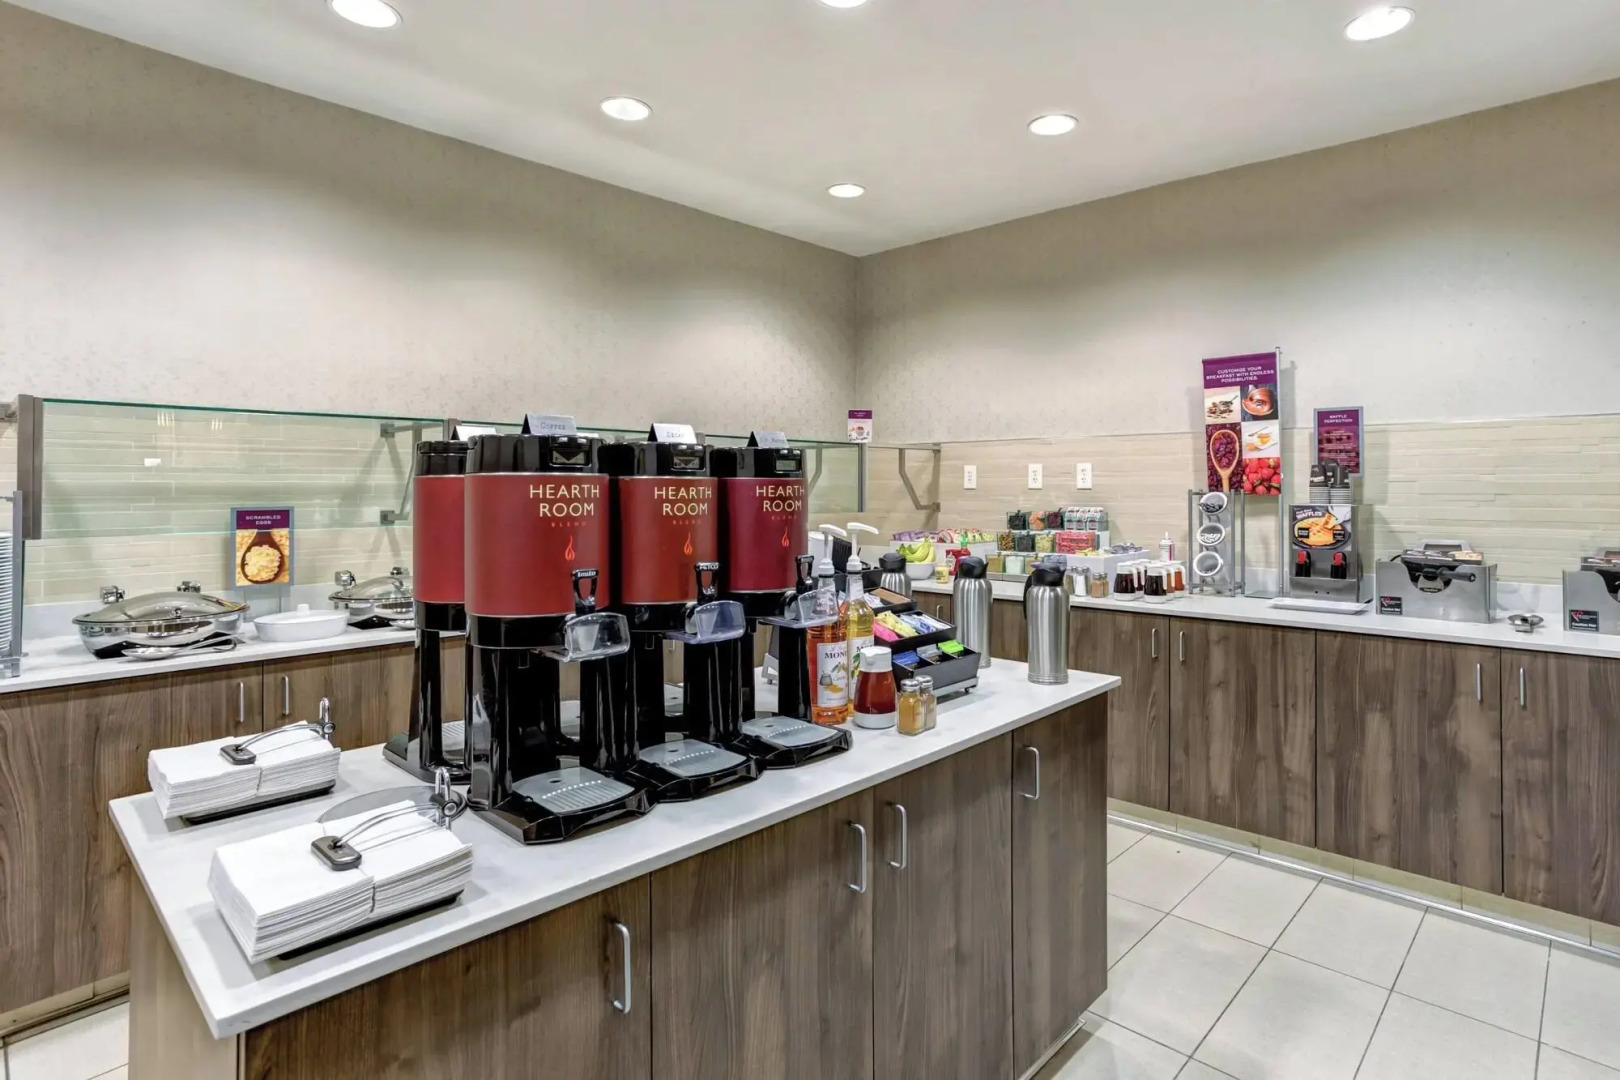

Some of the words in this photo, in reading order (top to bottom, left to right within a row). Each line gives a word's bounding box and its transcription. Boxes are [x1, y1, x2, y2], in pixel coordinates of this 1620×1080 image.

[530, 484, 600, 499] HEARTH
[654, 486, 712, 500] HEARTH
[756, 485, 805, 497] HEARTH
[539, 502, 594, 517] ROOM
[662, 502, 708, 516] ROOM
[763, 500, 802, 512] ROOM
